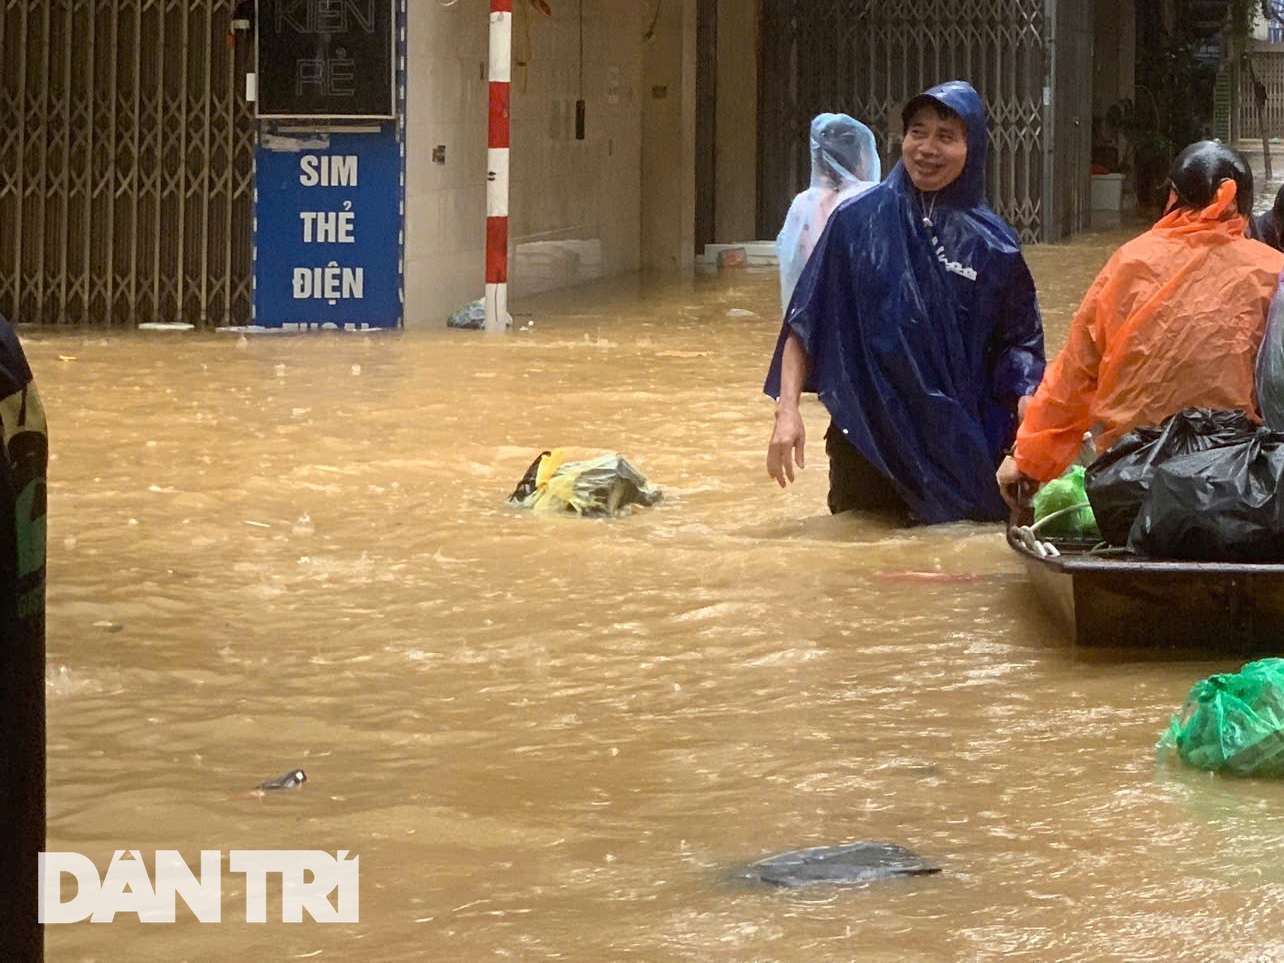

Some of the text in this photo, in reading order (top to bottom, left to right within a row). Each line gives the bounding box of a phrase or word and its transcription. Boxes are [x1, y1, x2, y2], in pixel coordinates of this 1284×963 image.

[300, 154, 358, 186] SIM
[300, 200, 355, 242] THẺ
[292, 260, 364, 305] ĐIỆN
